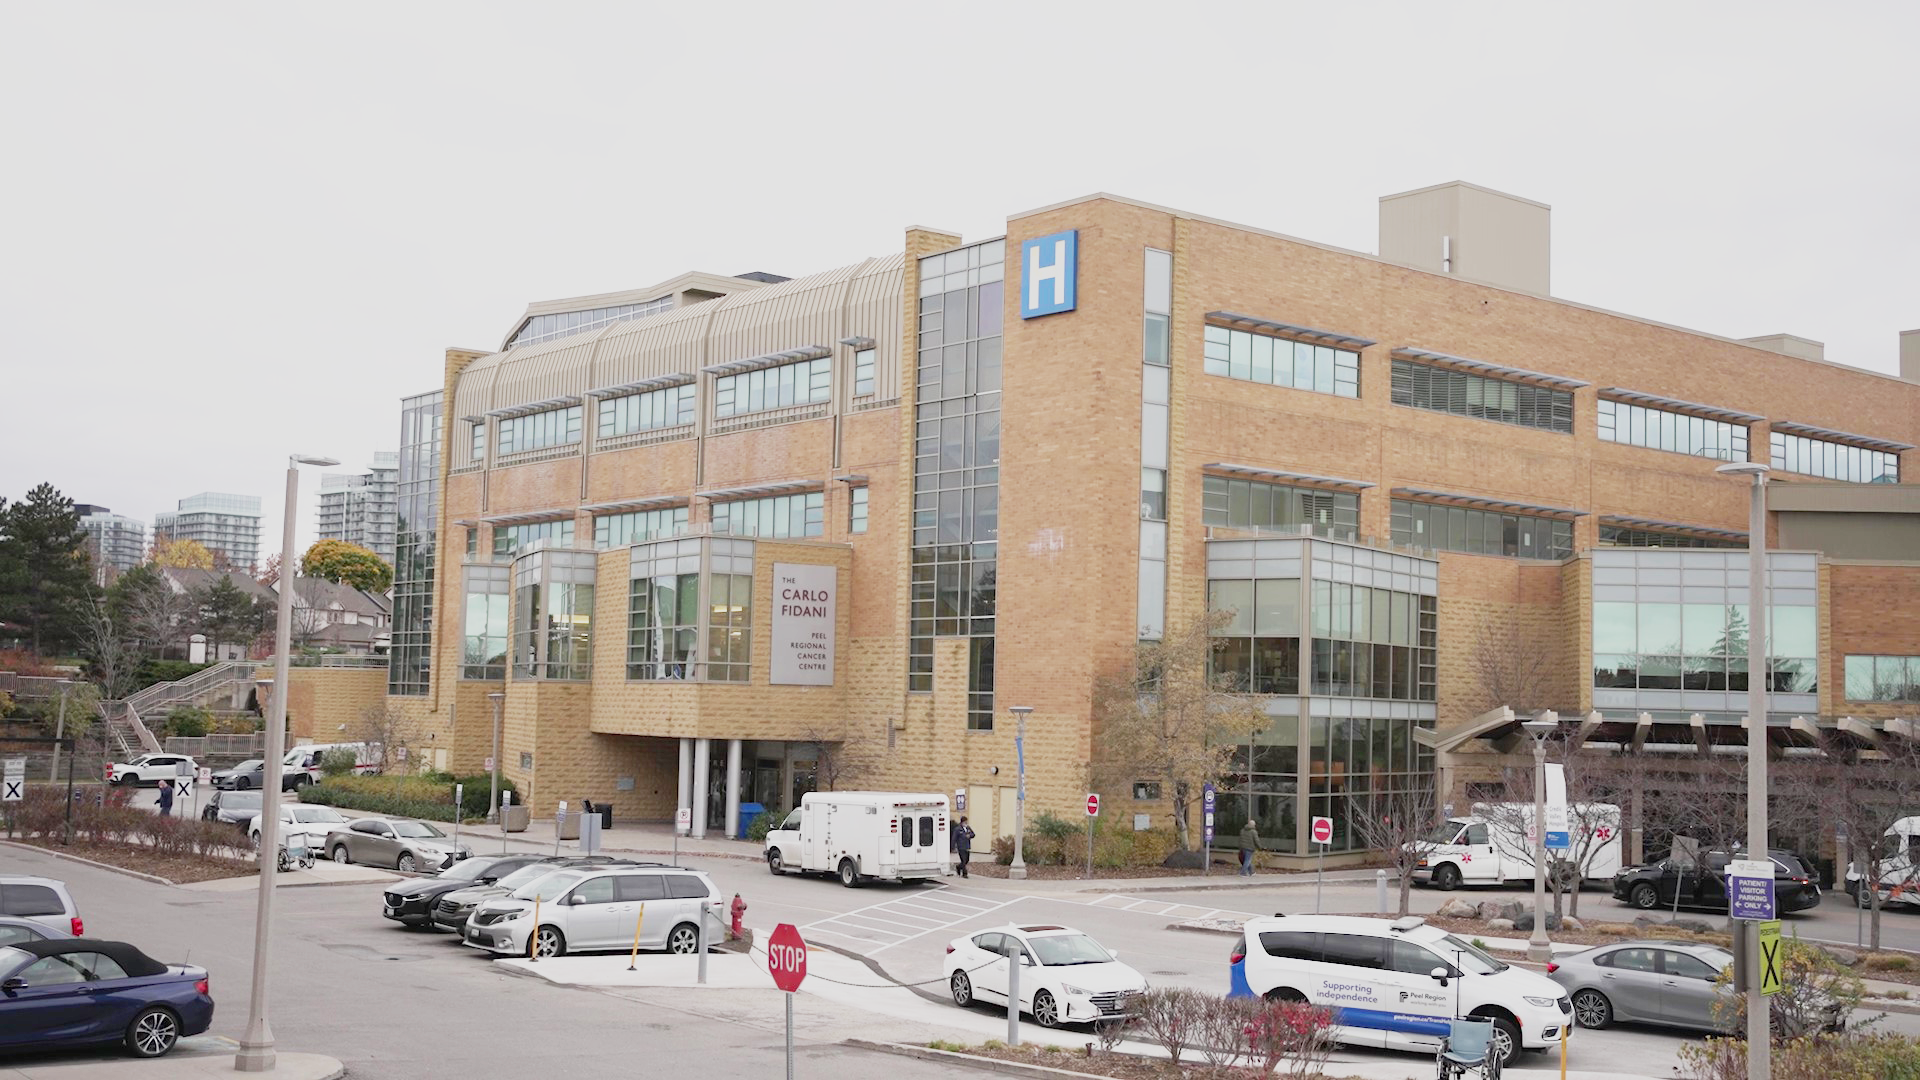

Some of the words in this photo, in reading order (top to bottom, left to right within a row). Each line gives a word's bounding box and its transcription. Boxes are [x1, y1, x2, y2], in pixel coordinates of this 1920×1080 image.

[1028, 239, 1066, 310] H
[782, 588, 829, 602] CARLO
[781, 604, 827, 618] FIDANI
[811, 632, 827, 640] PEEL
[790, 642, 827, 650] REGIONAL
[798, 663, 826, 671] CENTRE
[1740, 887, 1766, 895] VISITOR
[1738, 894, 1768, 902] PARKING
[770, 944, 805, 973] STOP
[1323, 980, 1372, 995] Supporting
[1316, 990, 1378, 1003] independence
[1425, 993, 1447, 1002] Region
